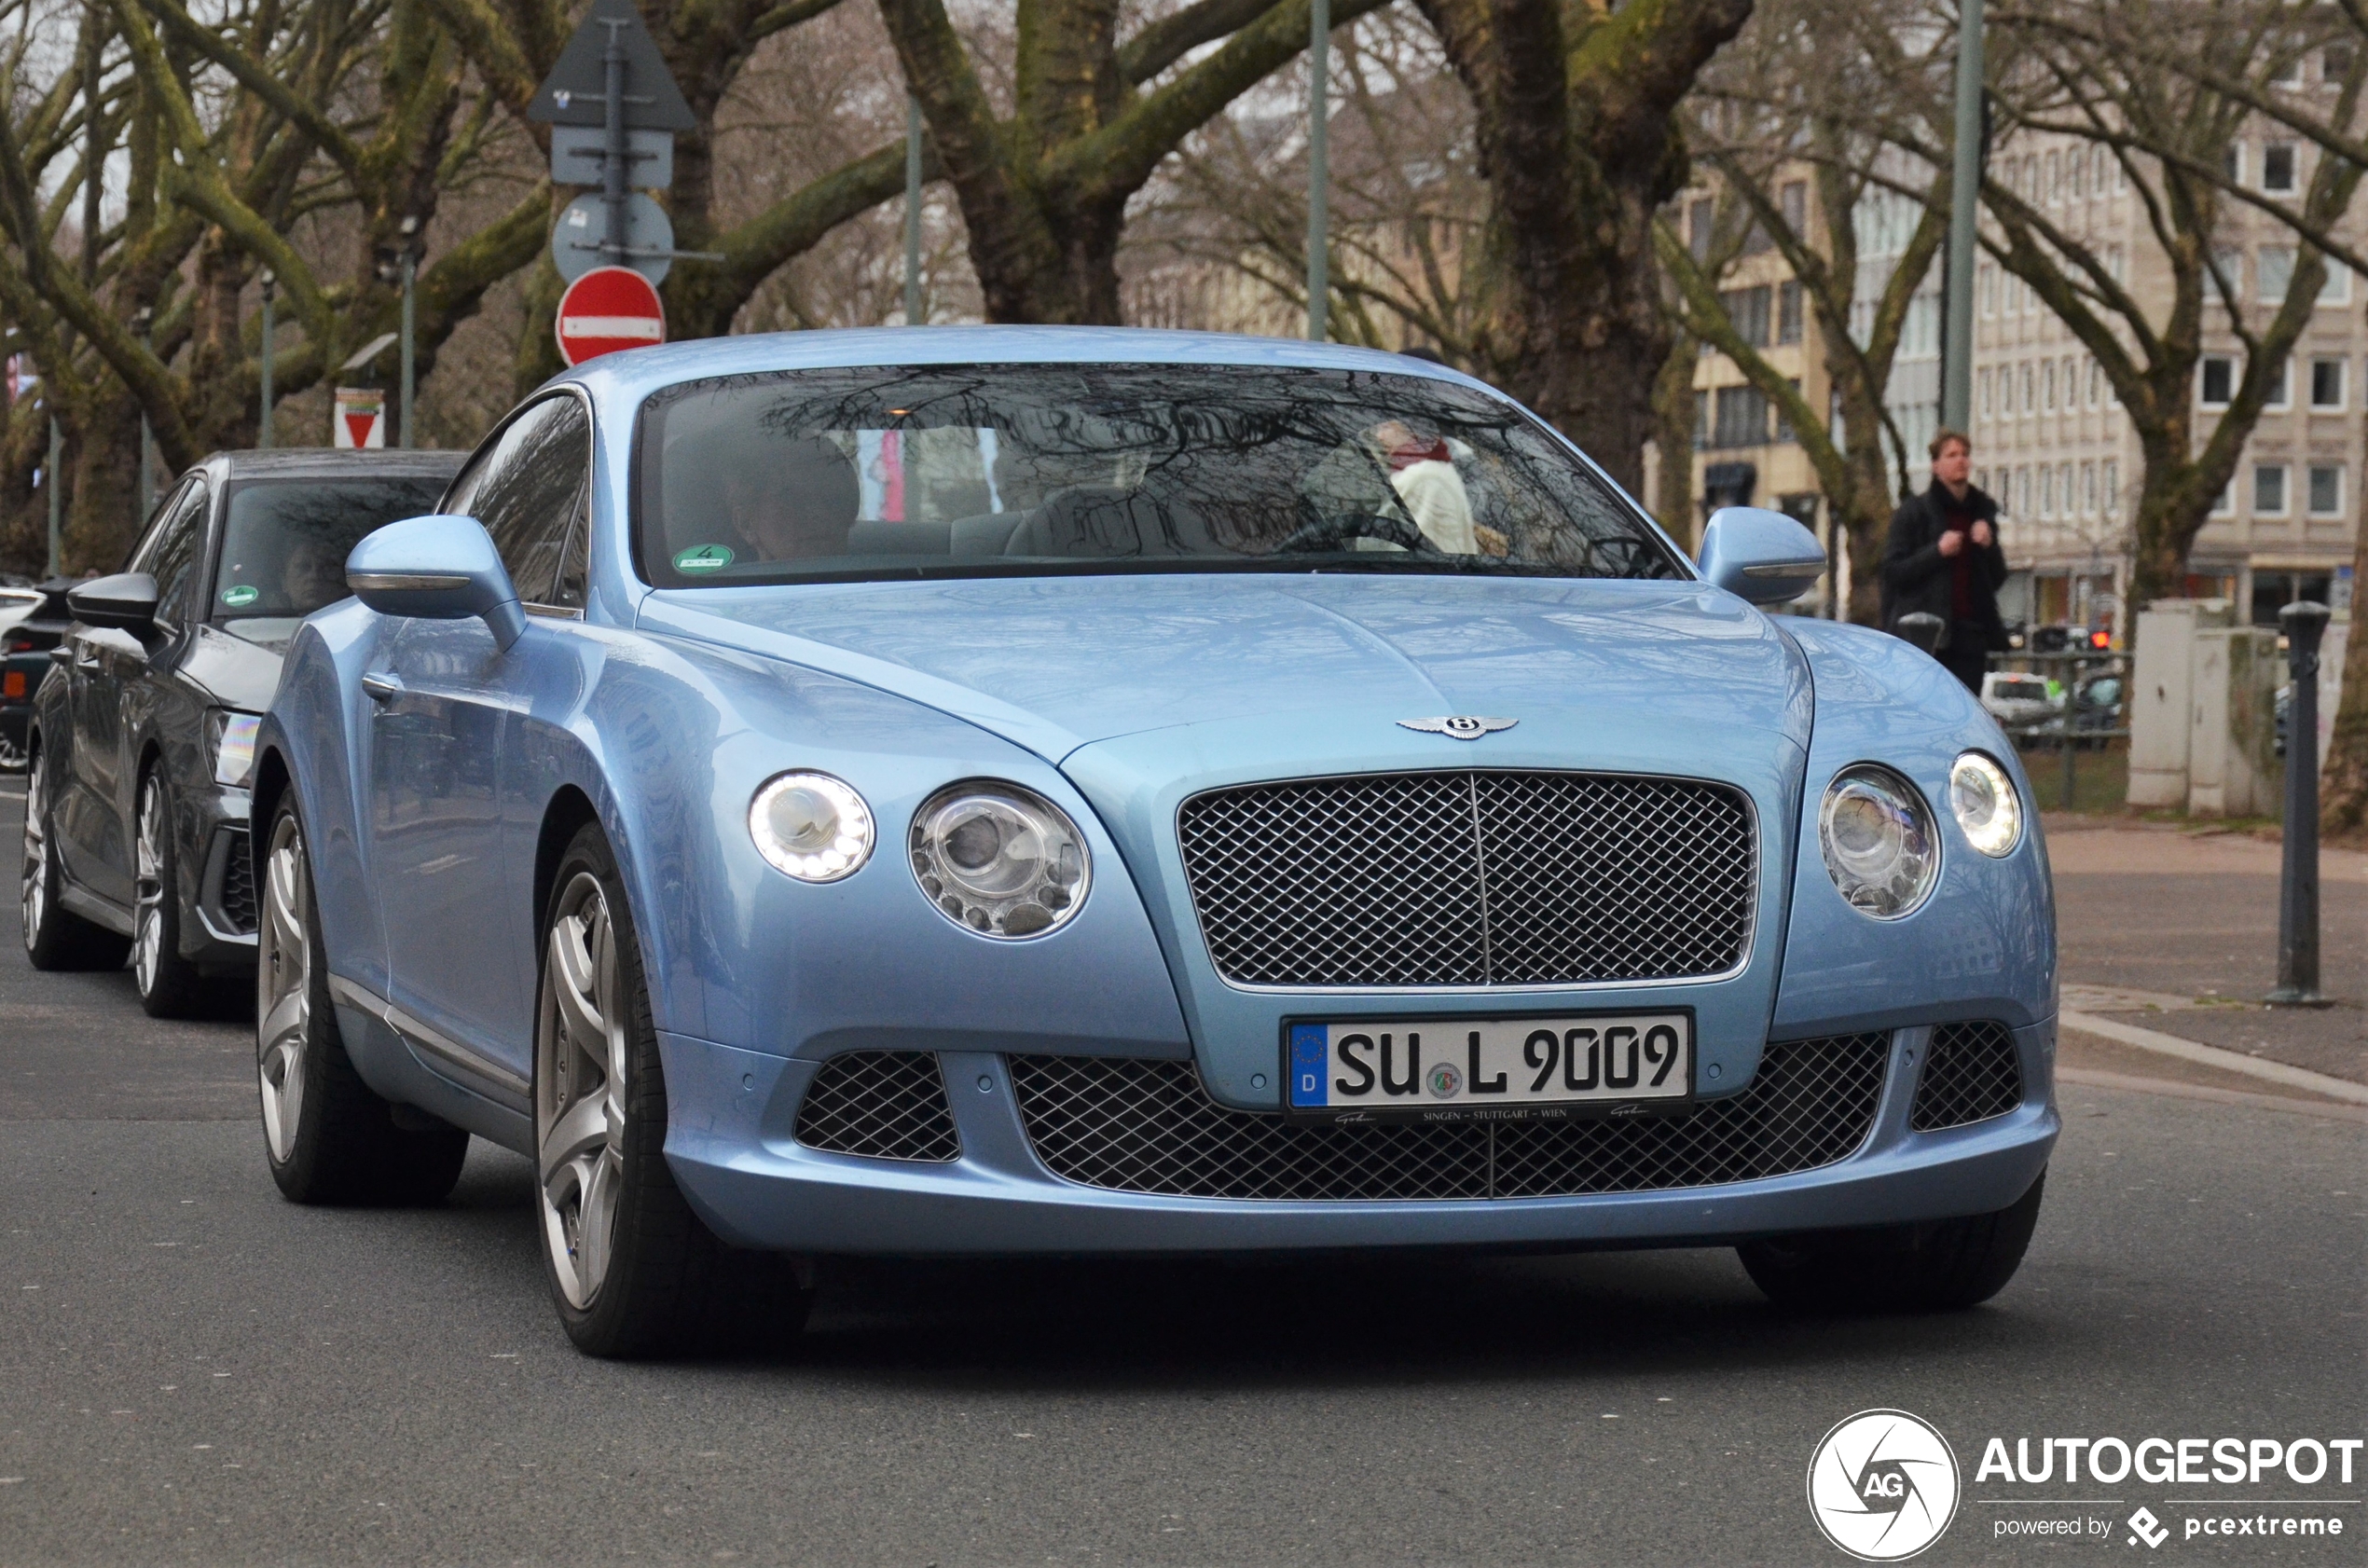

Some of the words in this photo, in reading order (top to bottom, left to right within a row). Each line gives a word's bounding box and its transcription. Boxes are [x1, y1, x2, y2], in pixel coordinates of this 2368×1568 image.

[1335, 1033, 1420, 1095] SU
[1468, 1031, 1507, 1093] L
[1523, 1025, 1678, 1092] 9009
[1301, 1074, 1315, 1092] D
[1424, 1111, 1461, 1121] SINGEN
[1473, 1109, 1529, 1120] STUTTGART
[1541, 1108, 1567, 1118] WIEN
